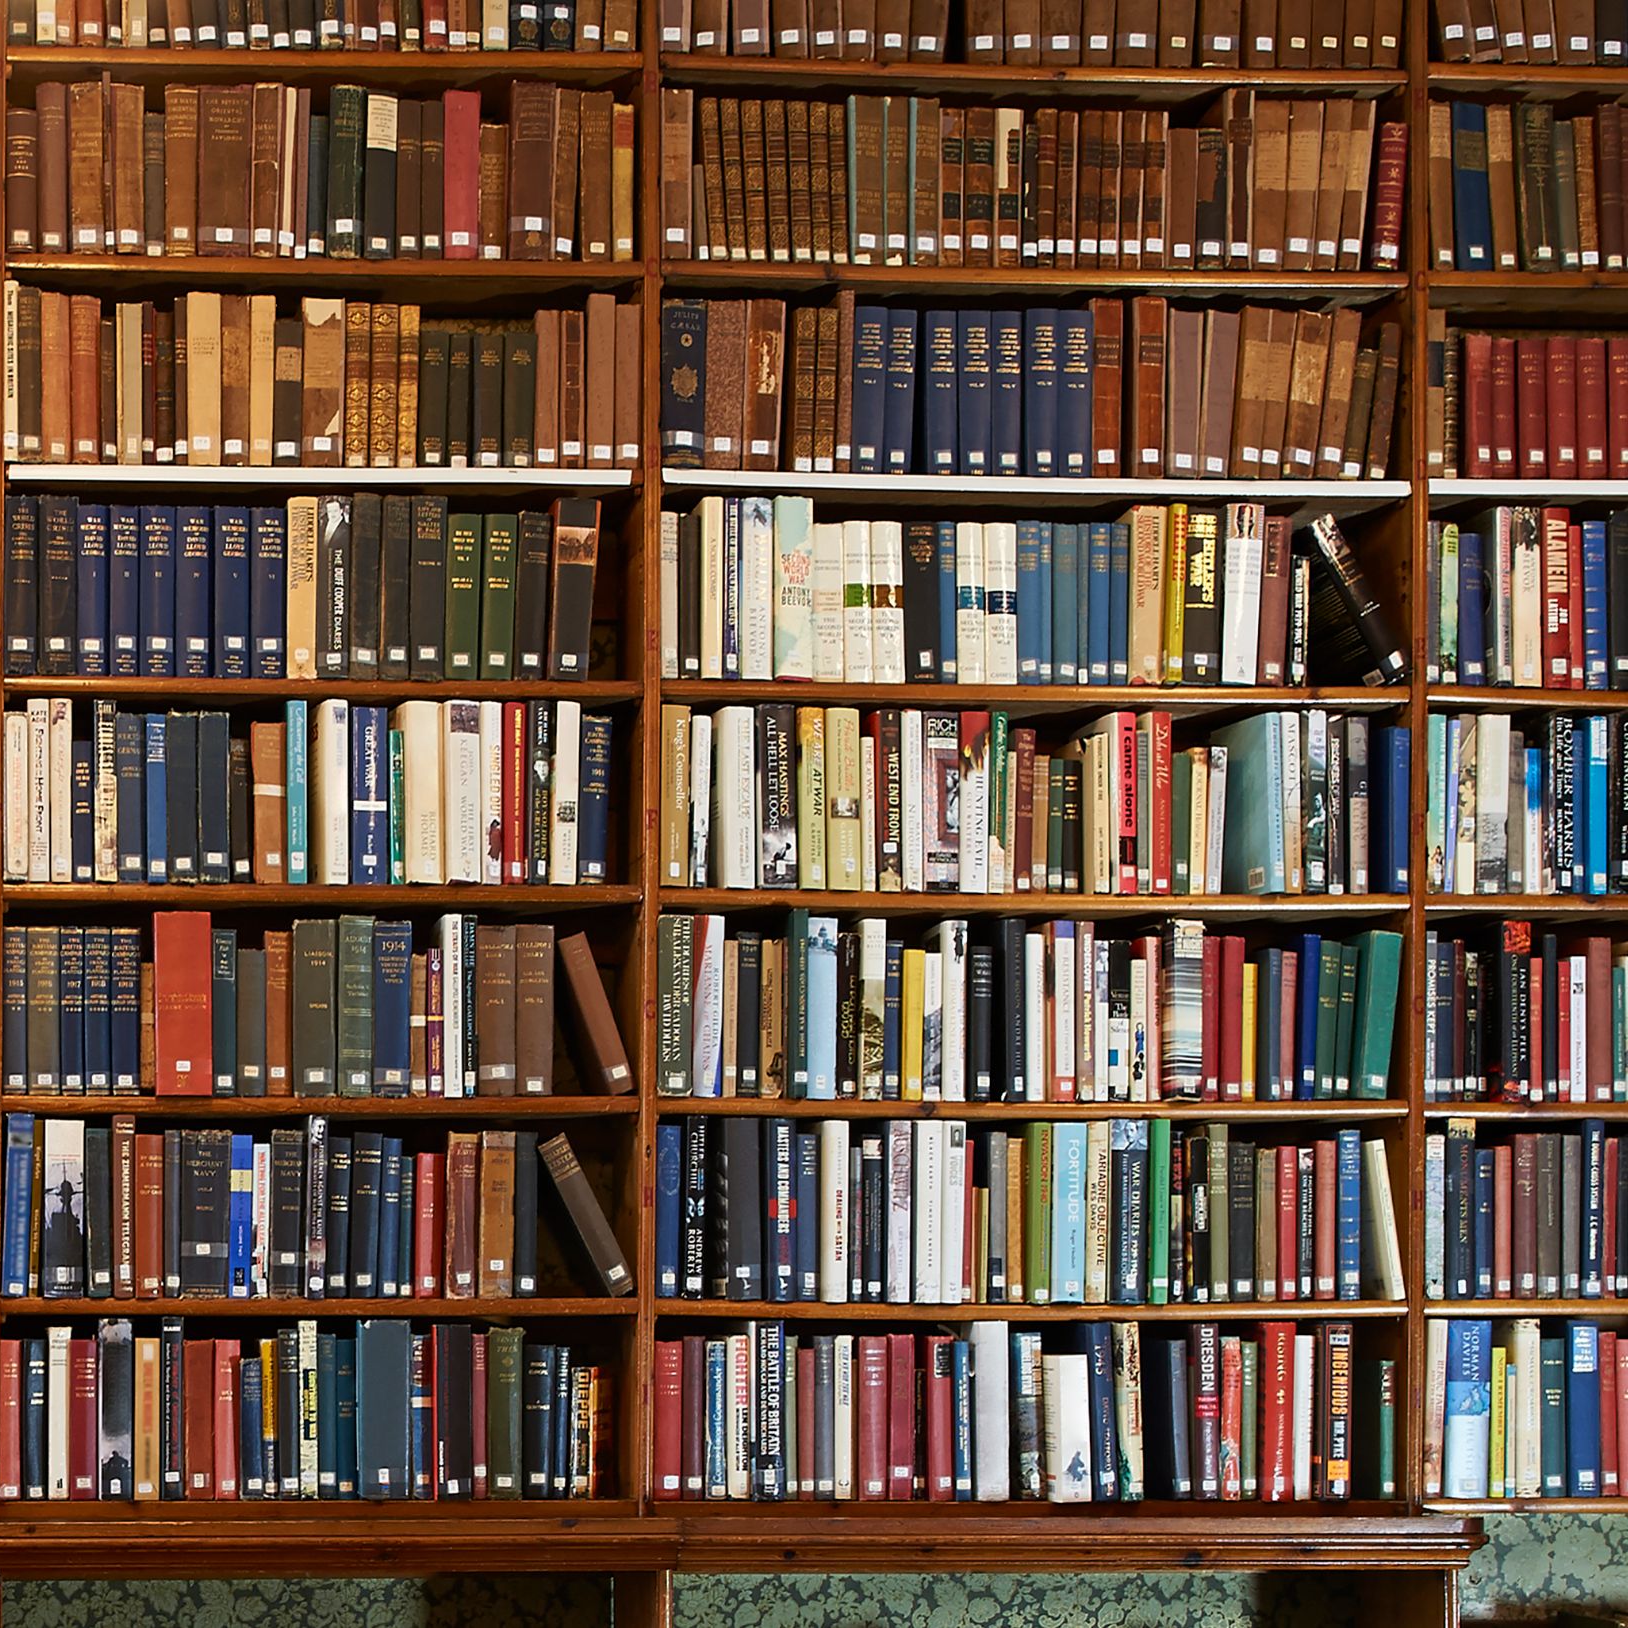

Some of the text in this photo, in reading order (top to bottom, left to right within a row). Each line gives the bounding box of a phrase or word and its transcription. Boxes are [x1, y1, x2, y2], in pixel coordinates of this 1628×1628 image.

[780, 555, 812, 565] SECOND
[783, 564, 810, 575] WORLD
[788, 576, 806, 585] WAR
[1190, 552, 1202, 586] WAR
[1202, 539, 1215, 602] HITLER'S
[1547, 519, 1567, 593] ALAMEIN
[334, 549, 344, 650] THE DUFF COOPER DIARIES
[781, 587, 811, 597] ANTONY
[781, 597, 812, 607] BEEVOR
[1548, 598, 1558, 633] LATIMER
[1559, 608, 1567, 624] JON
[813, 718, 822, 740] WE
[928, 718, 957, 730] RICH
[1288, 723, 1296, 781] MASCOT
[364, 727, 372, 787] GREAT WAR
[490, 745, 500, 818] SINGLED OUT
[674, 719, 685, 810] King's Counsellor
[767, 717, 778, 831] ALL HELL LET LOOSE
[778, 732, 788, 817] MAX HASTINGS
[813, 768, 822, 785] AT
[813, 787, 822, 816] WAR
[888, 752, 899, 842] WEST END FRONT
[975, 776, 983, 870] HUNTING EVIL
[1563, 717, 1573, 868] BOMBER HARRIS
[382, 941, 405, 951] 1914
[673, 917, 681, 1061] SIR ALEXANDER CADOGAN
[1427, 959, 1436, 1034] PROMISES KEPT
[663, 994, 671, 1062] DAVID DILKS
[690, 1132, 698, 1190] CHURCHILL
[777, 1126, 789, 1233] MASTERS AND COMMANDERS
[893, 1128, 909, 1212] AUSCHWITZ
[1068, 1139, 1079, 1222] FORTITUDE
[1097, 1152, 1106, 1266] ARIADNE OBJECTIVE
[1132, 1161, 1140, 1236] WAR DIARIES
[736, 1338, 748, 1405] FIGHTER
[1201, 1328, 1214, 1391] DRESDEN
[1332, 1347, 1348, 1415] INGENIOUS
[1471, 1326, 1479, 1381] NORMAN
[579, 1371, 589, 1430] DIEPPE
[768, 1326, 779, 1455] THE BATTLE OF BRITAIN
[1333, 1421, 1345, 1458] MR. PYKE
